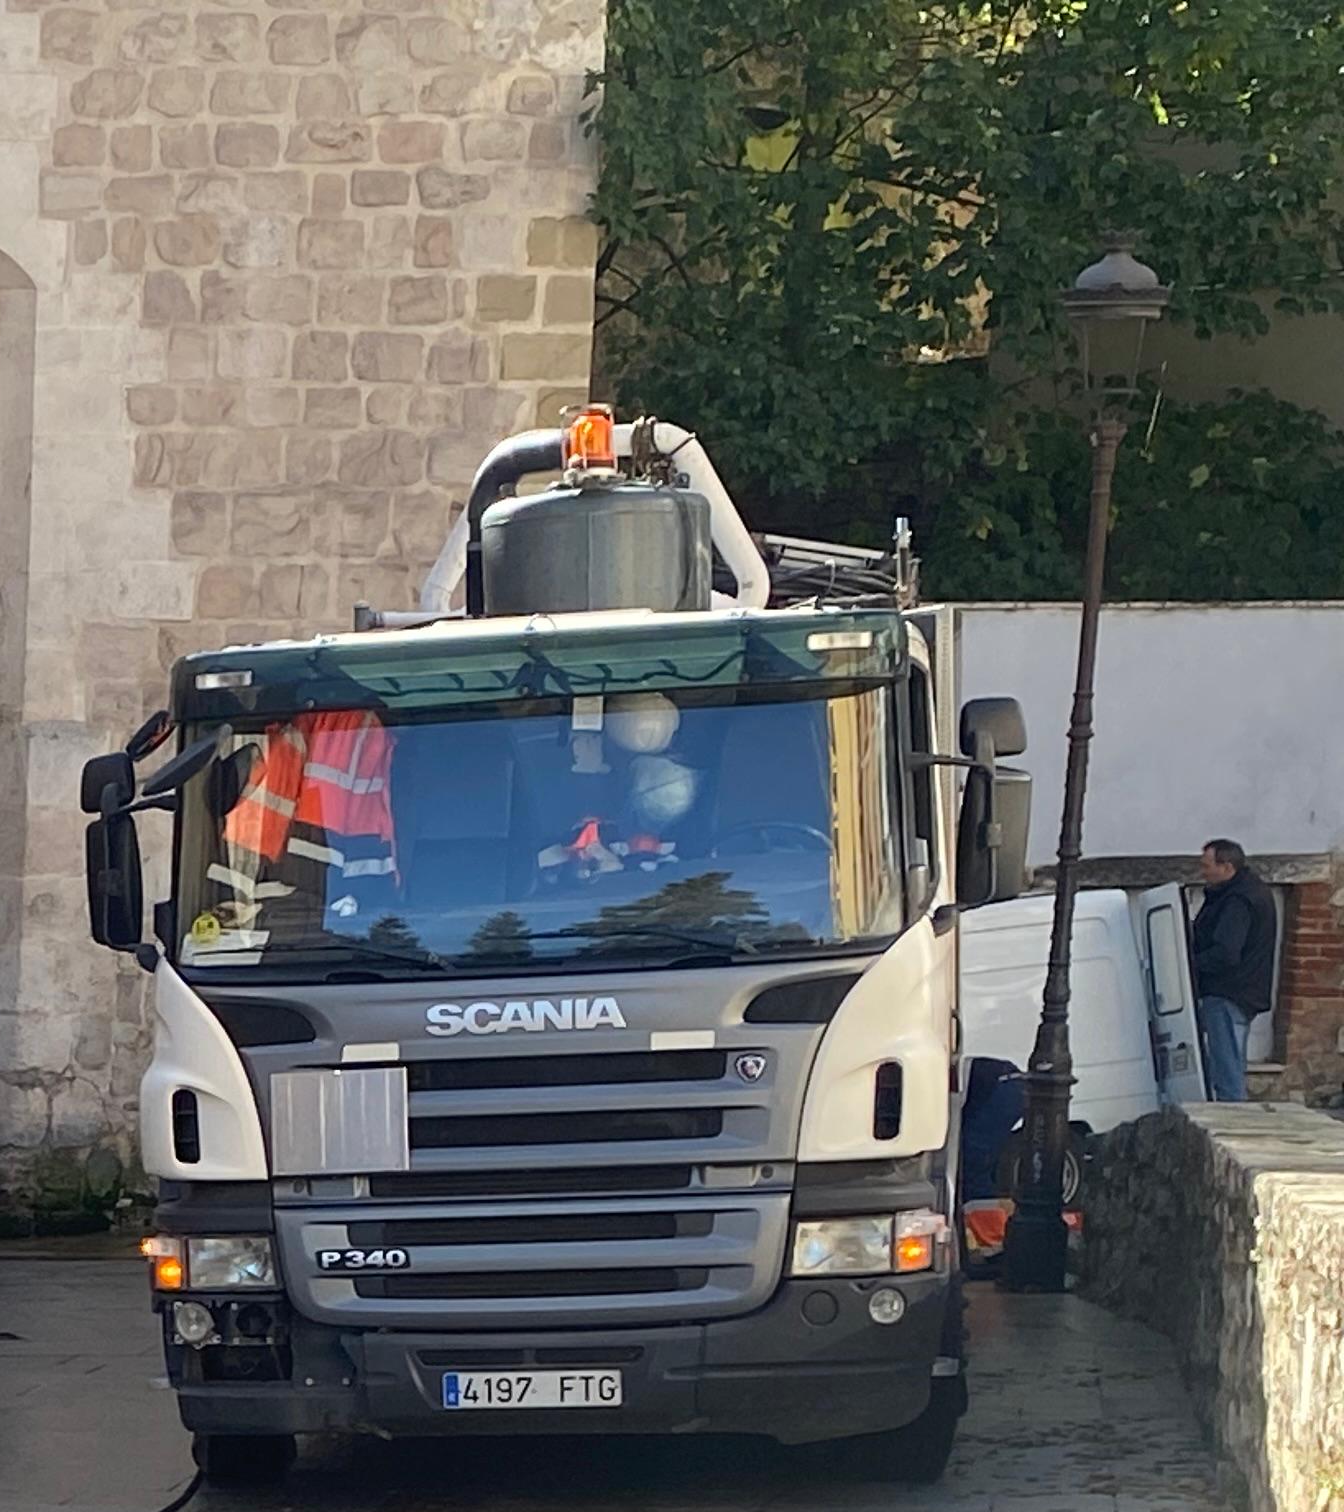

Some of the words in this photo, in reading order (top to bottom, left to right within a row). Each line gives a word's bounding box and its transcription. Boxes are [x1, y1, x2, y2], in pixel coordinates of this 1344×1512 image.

[425, 997, 627, 1036] SCANIA
[463, 1376, 532, 1404] 4197
[559, 1375, 616, 1402] FTG
